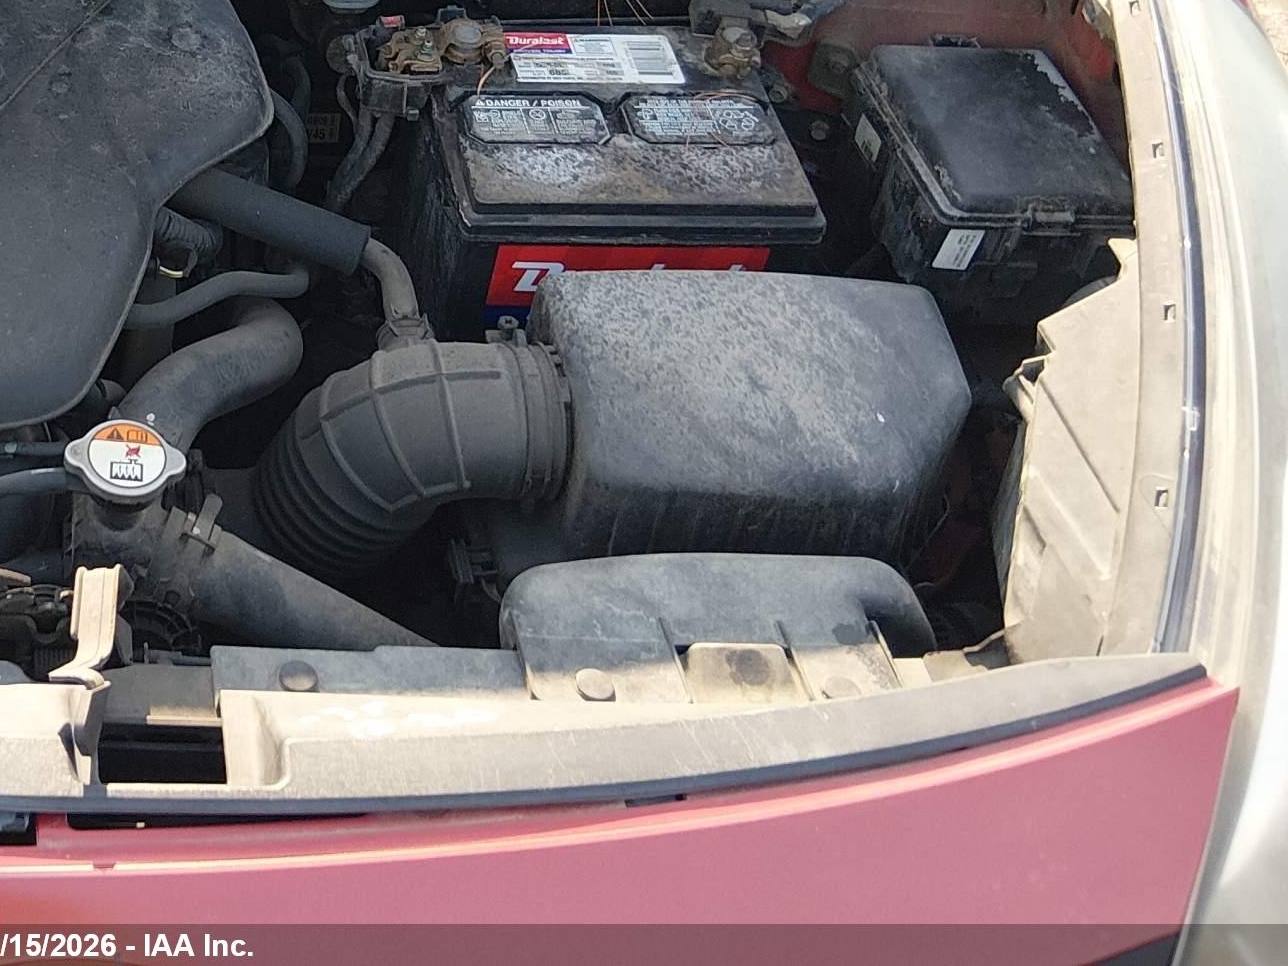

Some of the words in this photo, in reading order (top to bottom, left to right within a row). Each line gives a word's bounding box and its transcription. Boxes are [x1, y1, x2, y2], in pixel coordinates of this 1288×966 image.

[506, 36, 564, 45] Duralast
[485, 99, 530, 107] DANGER
[540, 99, 582, 107] POISON
